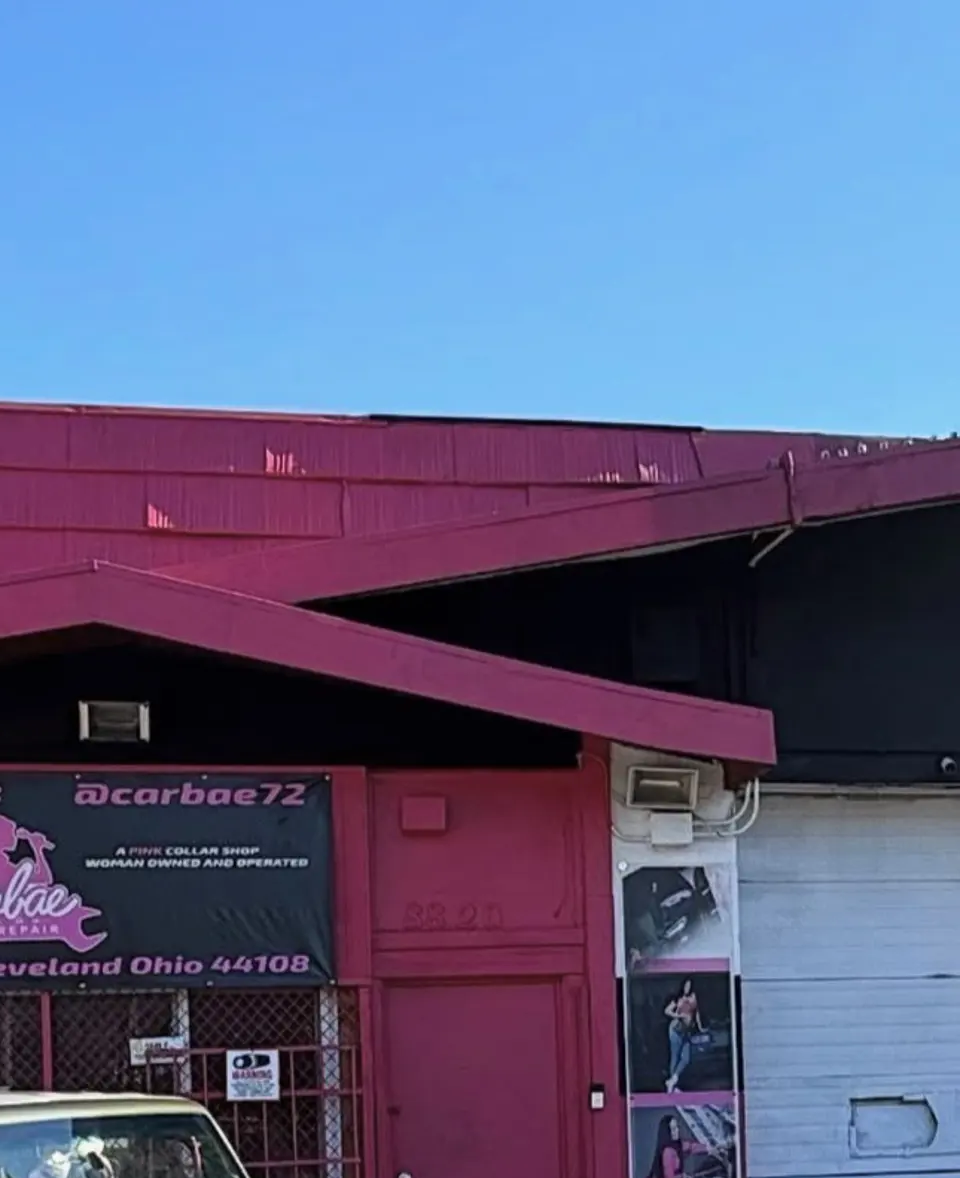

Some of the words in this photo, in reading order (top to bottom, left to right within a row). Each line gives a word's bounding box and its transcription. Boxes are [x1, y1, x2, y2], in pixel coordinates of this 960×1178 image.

[74, 783, 306, 806] @carbae72
[115, 847, 126, 856] A
[128, 847, 162, 856] PINK
[165, 847, 219, 856] COLLAR
[222, 847, 260, 856] SHOP
[85, 858, 144, 868] WOMAN
[147, 858, 200, 868] OWNED
[203, 858, 234, 868] AND
[236, 858, 309, 868] OPERATED
[130, 955, 203, 976] Ohio
[210, 954, 310, 975] 44108
